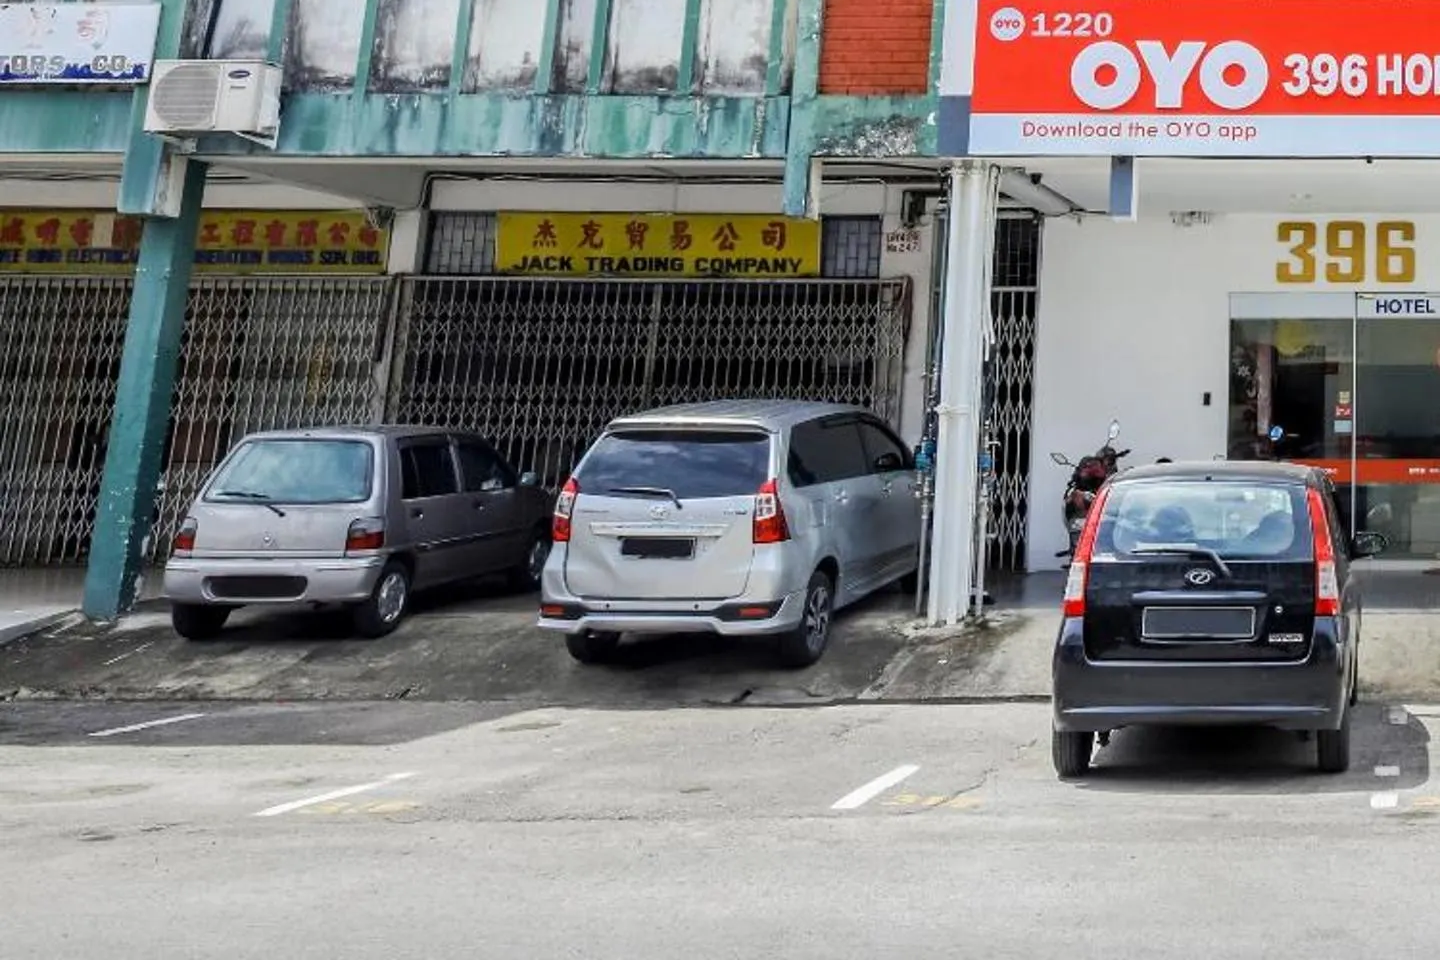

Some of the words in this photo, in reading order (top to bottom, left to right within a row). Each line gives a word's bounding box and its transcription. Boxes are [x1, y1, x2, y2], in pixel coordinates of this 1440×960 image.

[994, 19, 1021, 29] OYO
[1031, 13, 1113, 37] 1220
[1071, 40, 1268, 110] OYO
[1282, 53, 1368, 96] 396
[1023, 121, 1121, 137] Download
[1129, 122, 1158, 137] the
[1167, 123, 1210, 137] OYO
[1219, 124, 1257, 141] app
[533, 219, 787, 252] 杰克貿易公司
[513, 256, 572, 271] JACK
[584, 256, 684, 272] TRADING
[694, 257, 802, 273] COMPANY
[1276, 221, 1416, 283] 396
[1375, 298, 1436, 314] HOTEL
